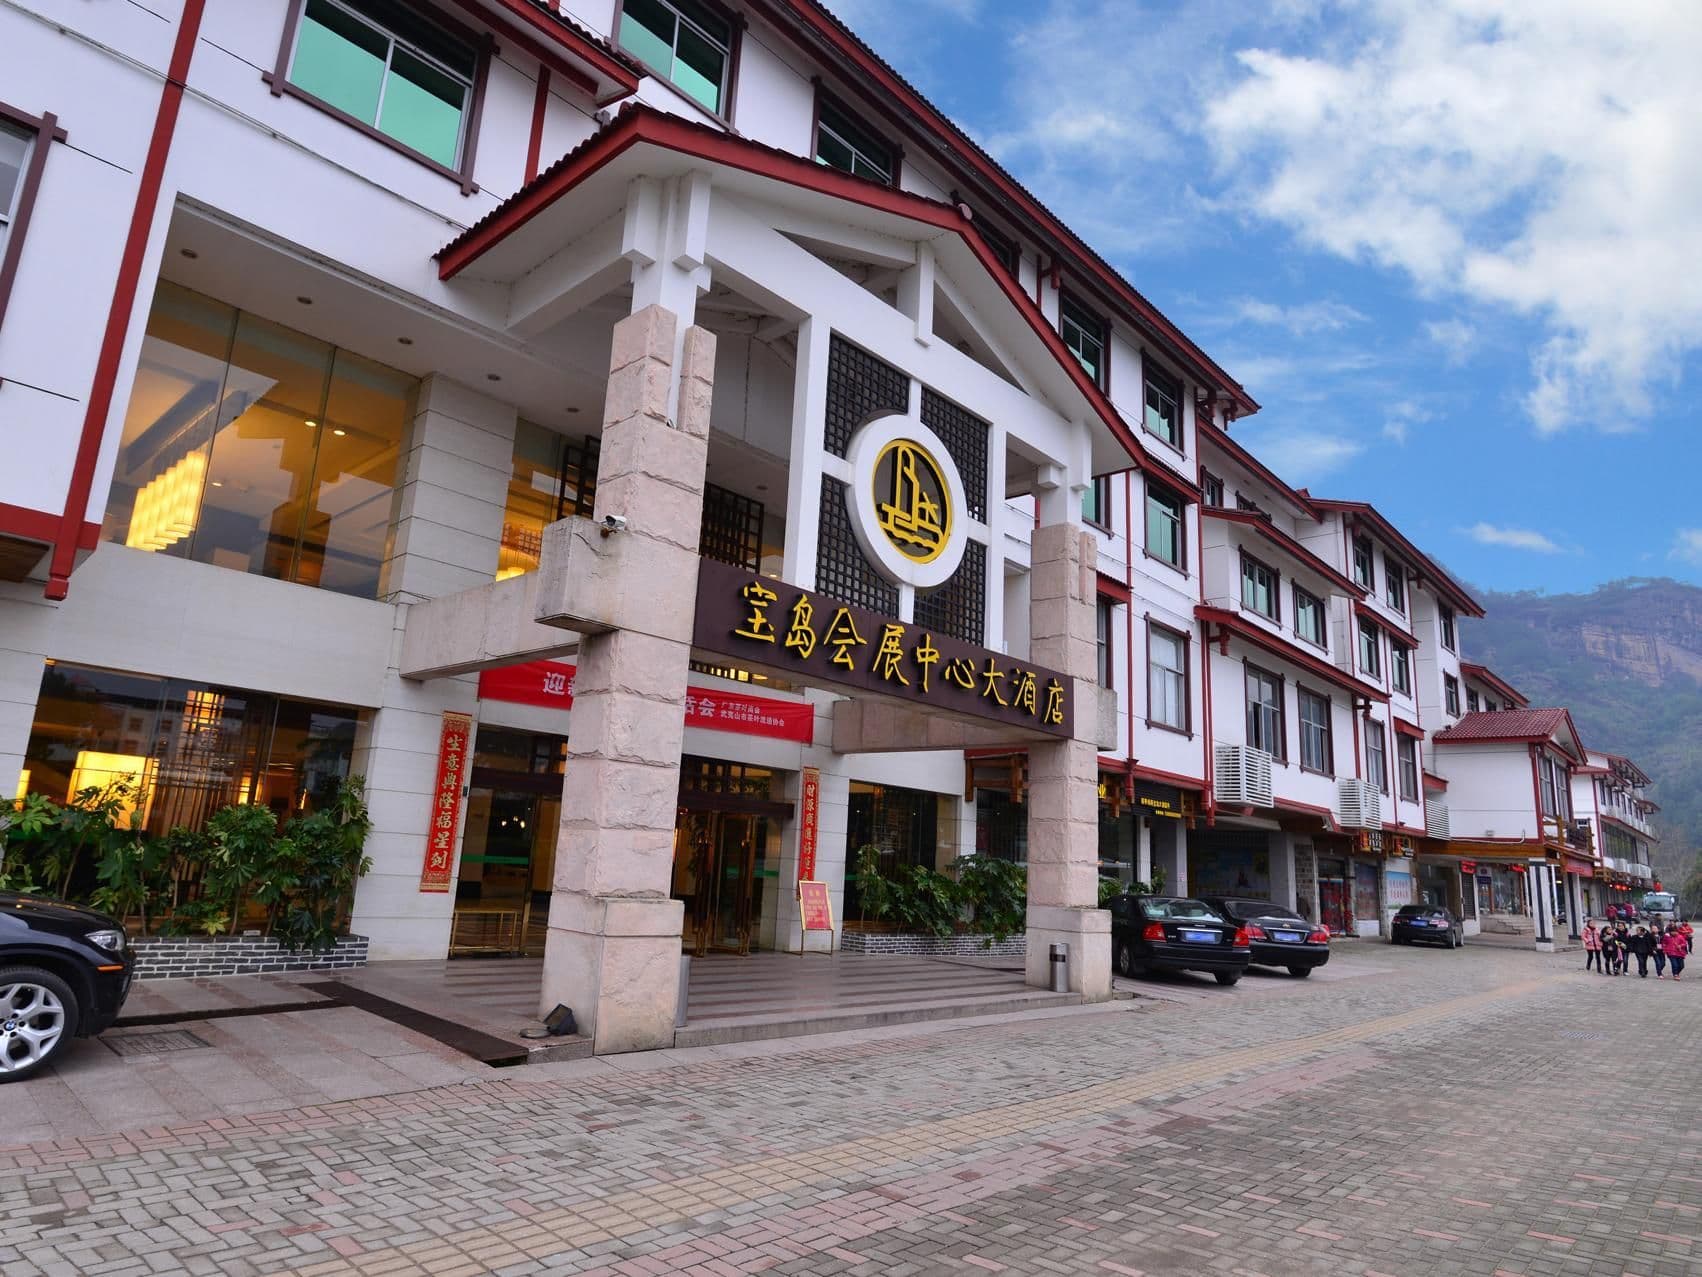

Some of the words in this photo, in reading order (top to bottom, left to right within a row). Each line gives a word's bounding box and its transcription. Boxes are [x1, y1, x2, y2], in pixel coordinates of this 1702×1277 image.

[734, 581, 1065, 725] 宝岛会展中心大酒店
